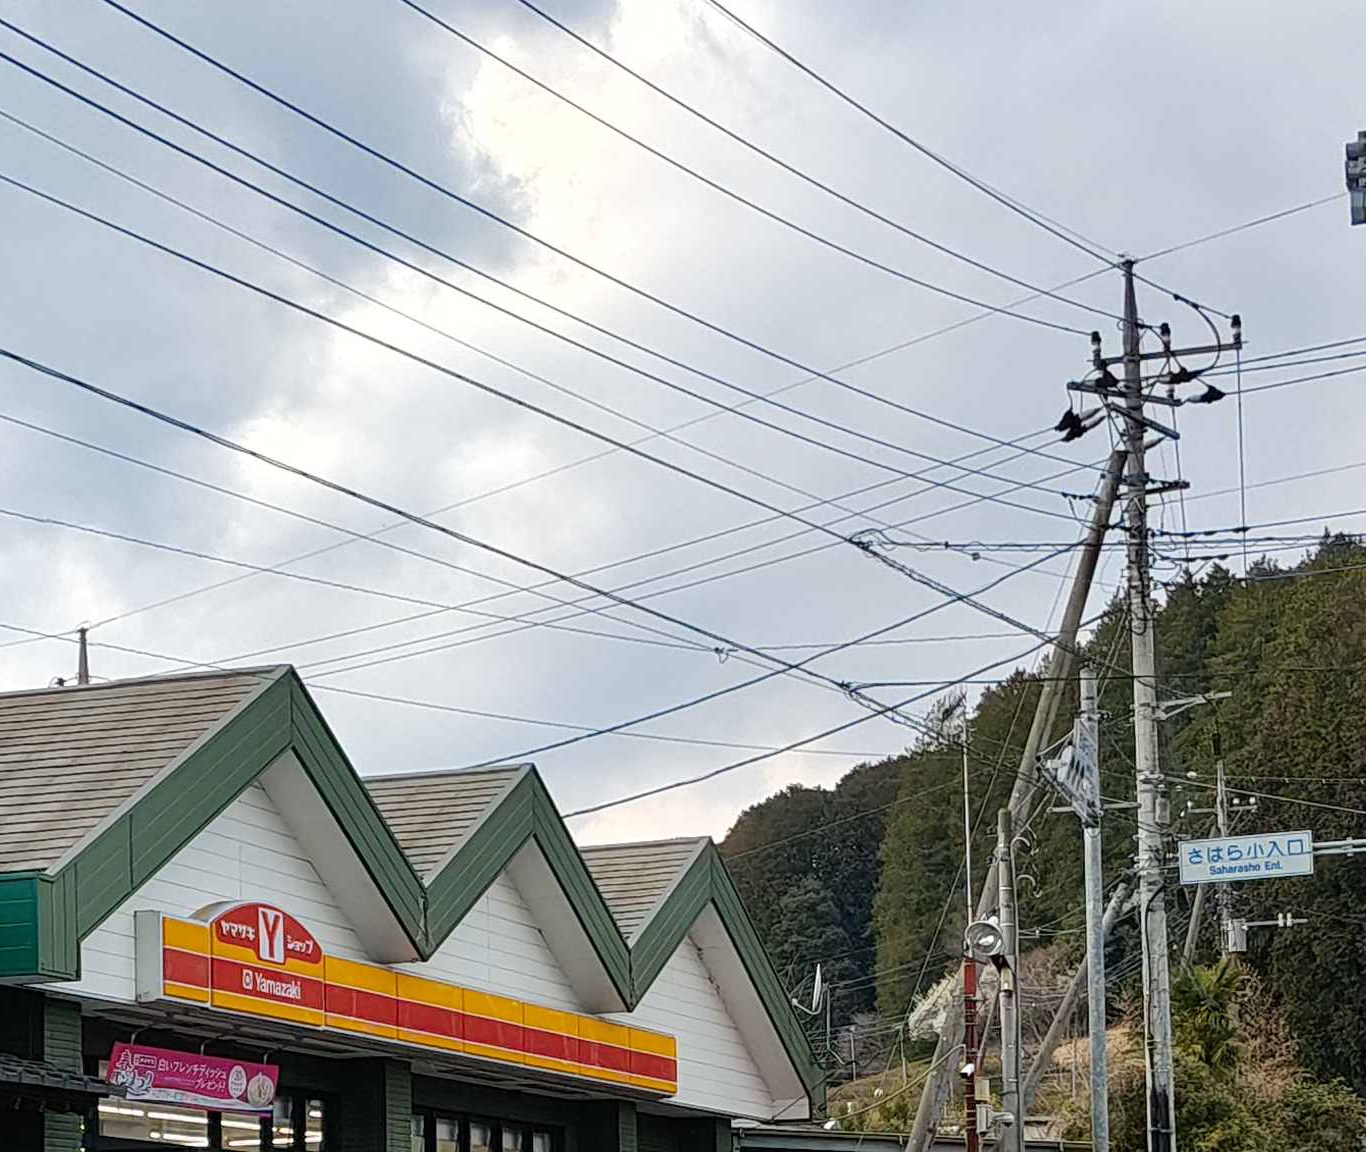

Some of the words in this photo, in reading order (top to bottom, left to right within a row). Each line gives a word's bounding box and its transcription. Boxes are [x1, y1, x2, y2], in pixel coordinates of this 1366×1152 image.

[1187, 839, 1304, 865] さはら小入口
[1209, 862, 1261, 876] Saharasho
[286, 934, 314, 955] ショップ
[254, 971, 301, 1000] Yamazaki
